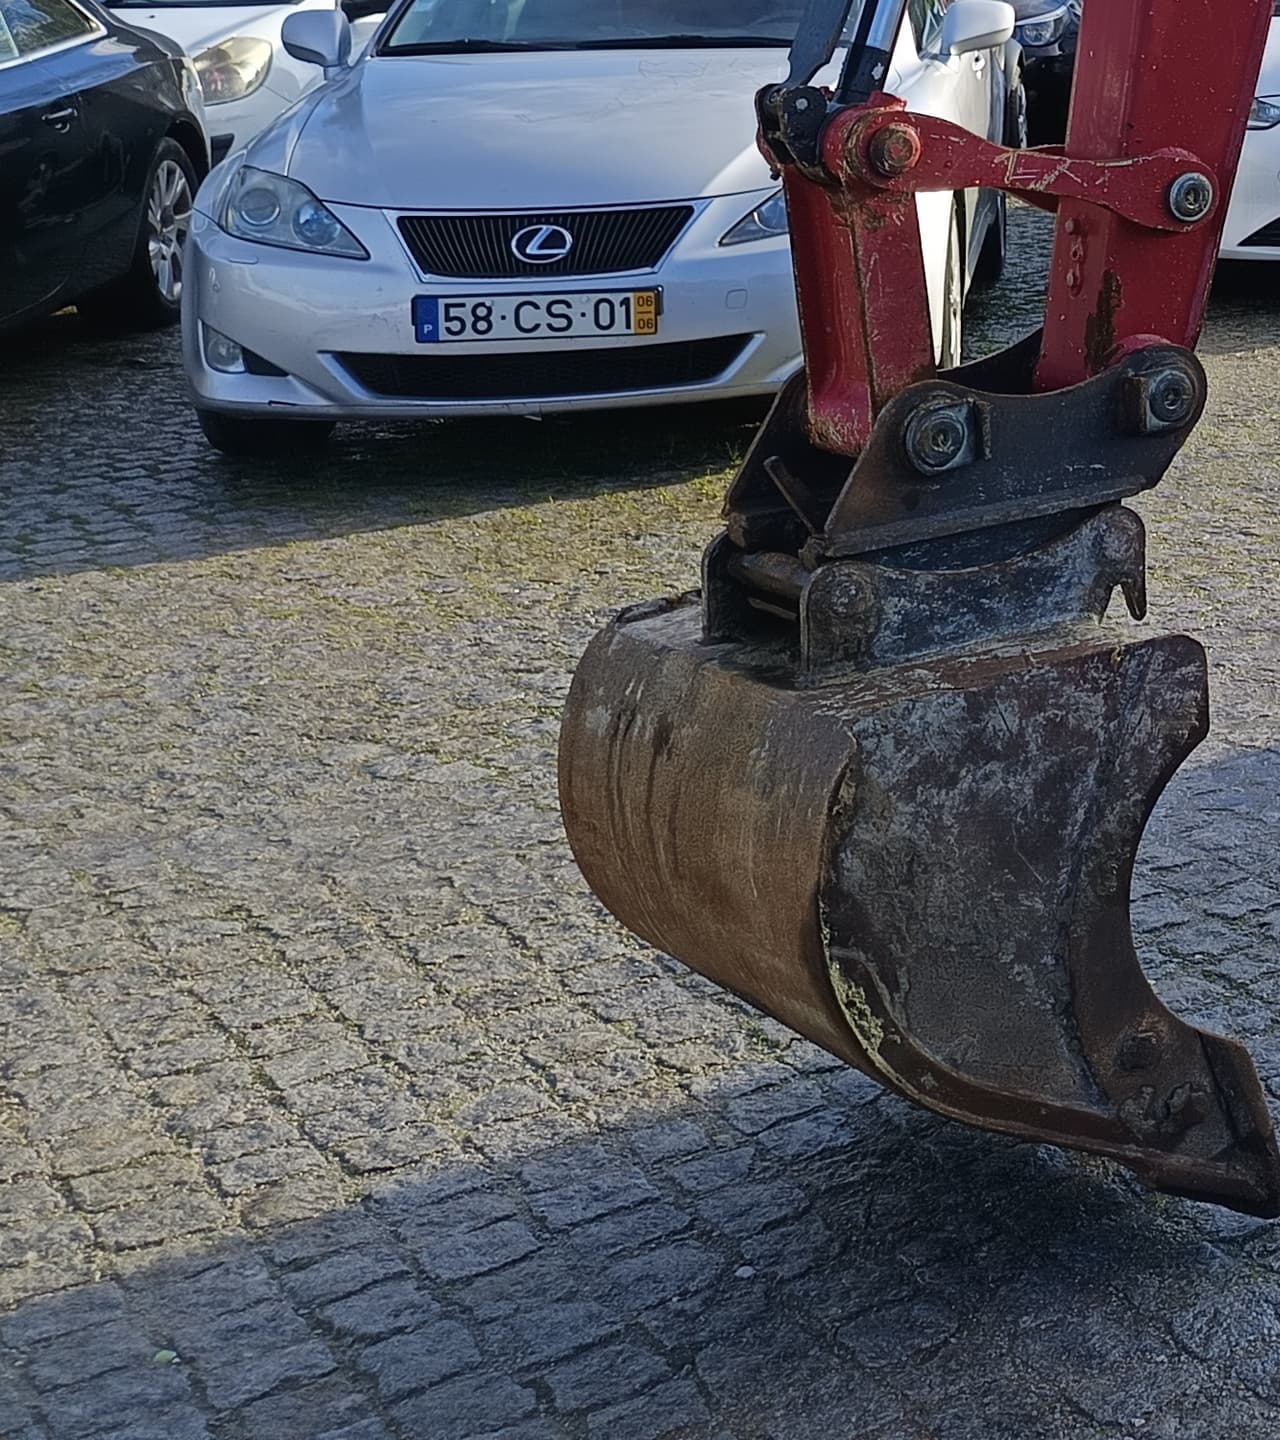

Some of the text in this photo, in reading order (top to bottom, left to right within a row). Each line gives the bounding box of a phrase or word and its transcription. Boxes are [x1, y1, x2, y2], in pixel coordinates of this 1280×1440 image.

[637, 296, 654, 308] 06
[423, 324, 433, 334] P
[637, 318, 654, 330] 06
